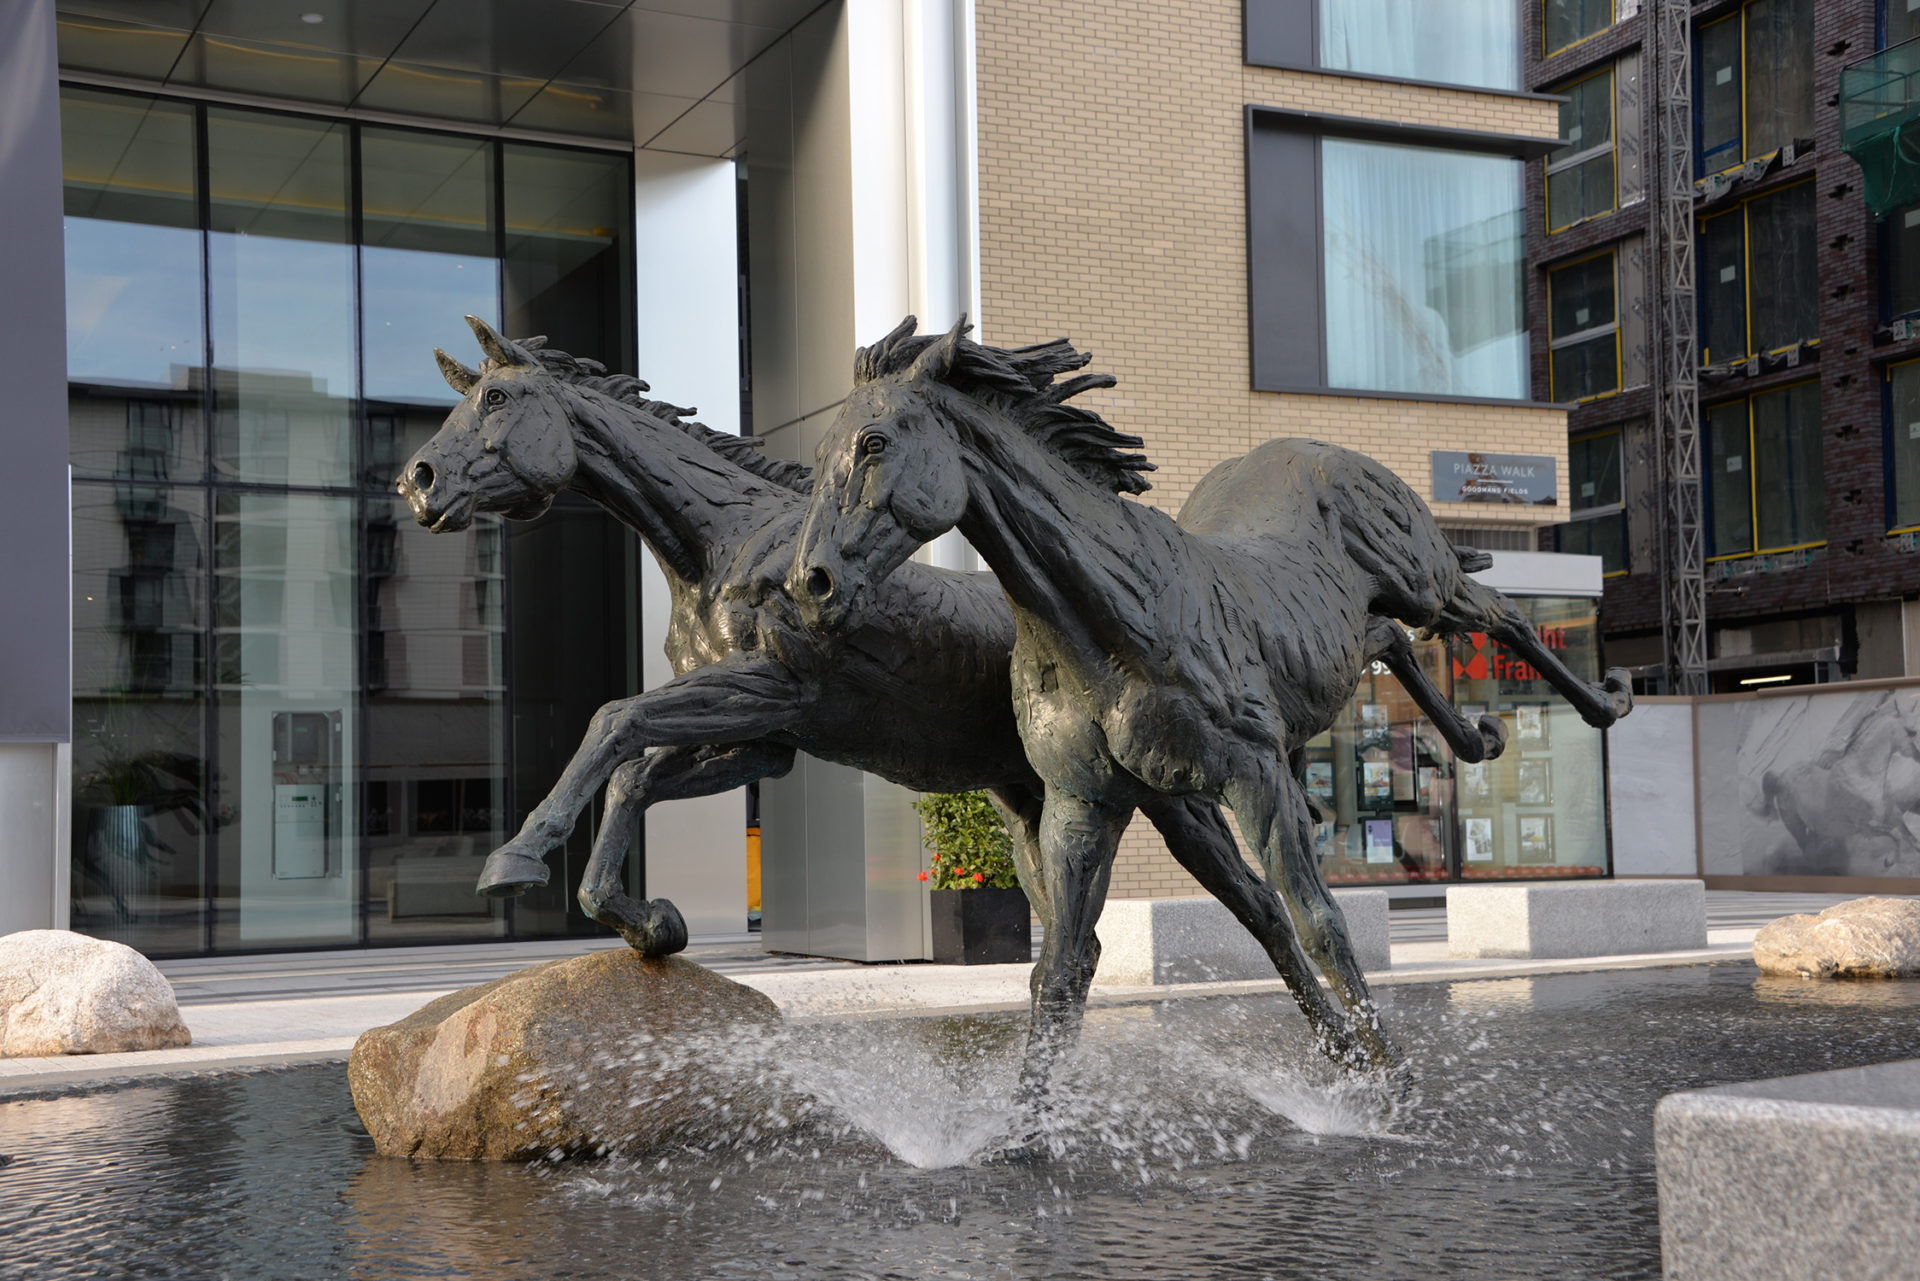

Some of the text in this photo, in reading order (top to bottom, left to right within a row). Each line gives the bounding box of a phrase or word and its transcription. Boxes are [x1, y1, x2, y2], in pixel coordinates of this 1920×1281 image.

[1453, 463, 1535, 478] PIAZZA WALK
[1462, 486, 1529, 495] GOODMANS FIELDS
[1493, 655, 1542, 681] Fran
